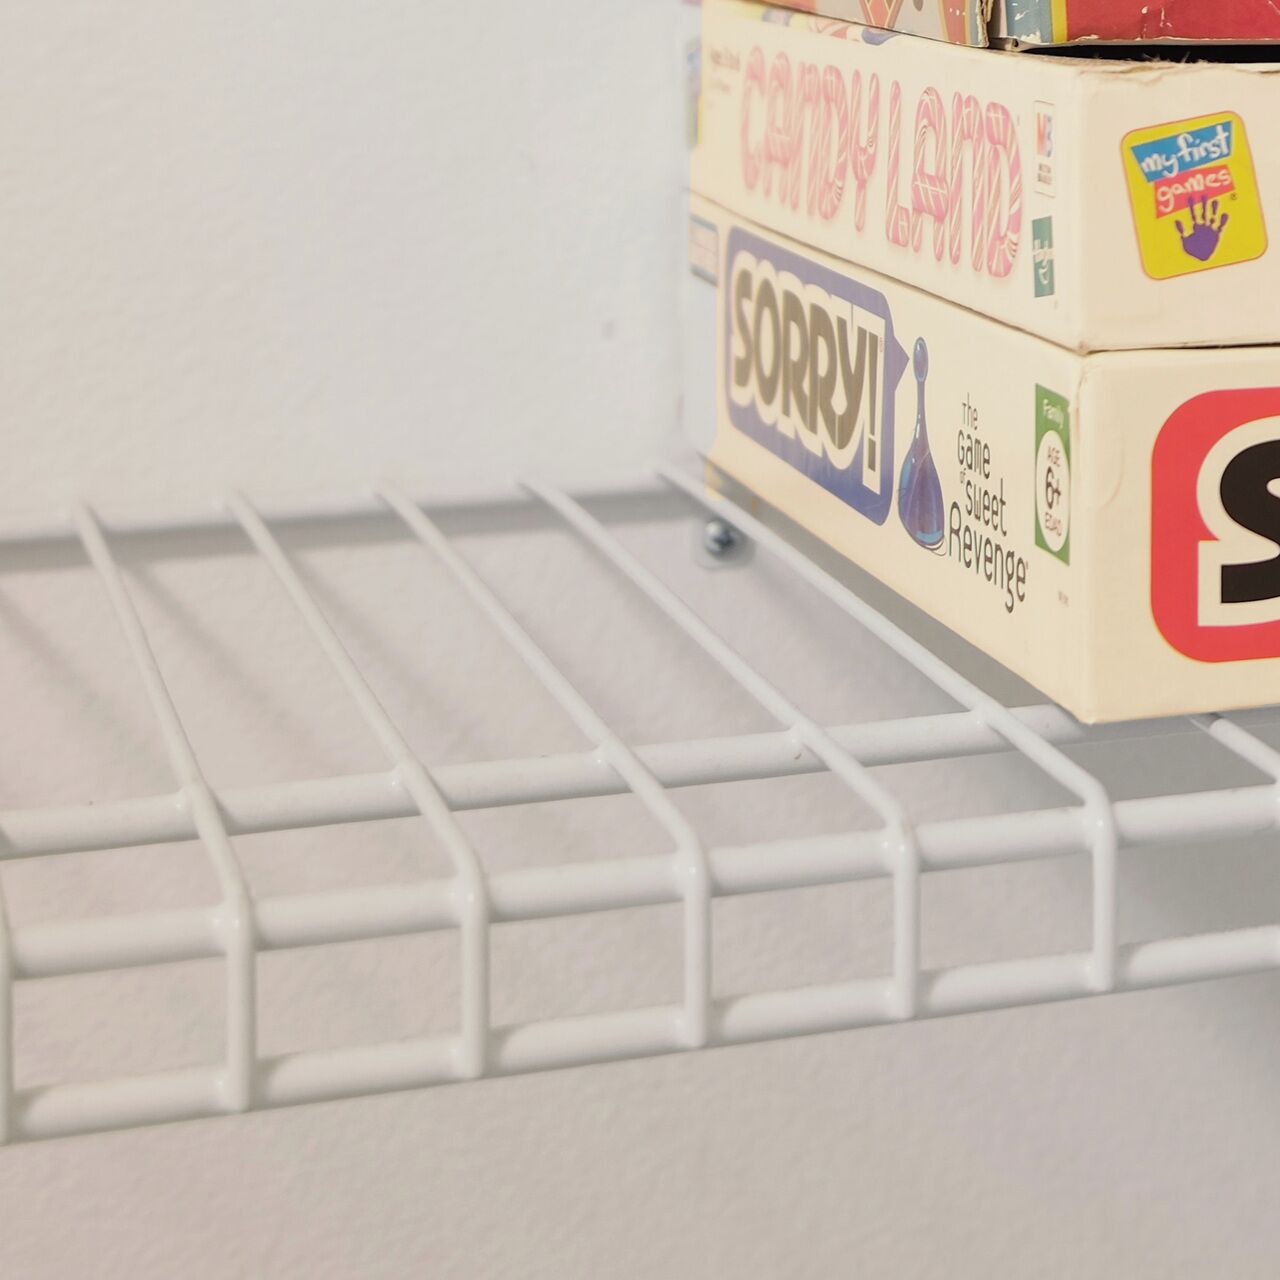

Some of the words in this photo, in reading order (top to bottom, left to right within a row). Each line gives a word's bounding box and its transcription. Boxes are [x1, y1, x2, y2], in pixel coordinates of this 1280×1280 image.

[742, 45, 880, 233] CANDY
[886, 79, 1024, 278] LAND
[1141, 151, 1179, 179] my
[1177, 125, 1230, 165] first
[1156, 167, 1233, 213] games
[733, 267, 880, 474] SORRY!
[961, 391, 978, 430] The
[957, 428, 991, 480] Game
[1045, 465, 1062, 510] 6+
[949, 500, 1027, 614] Revenge
